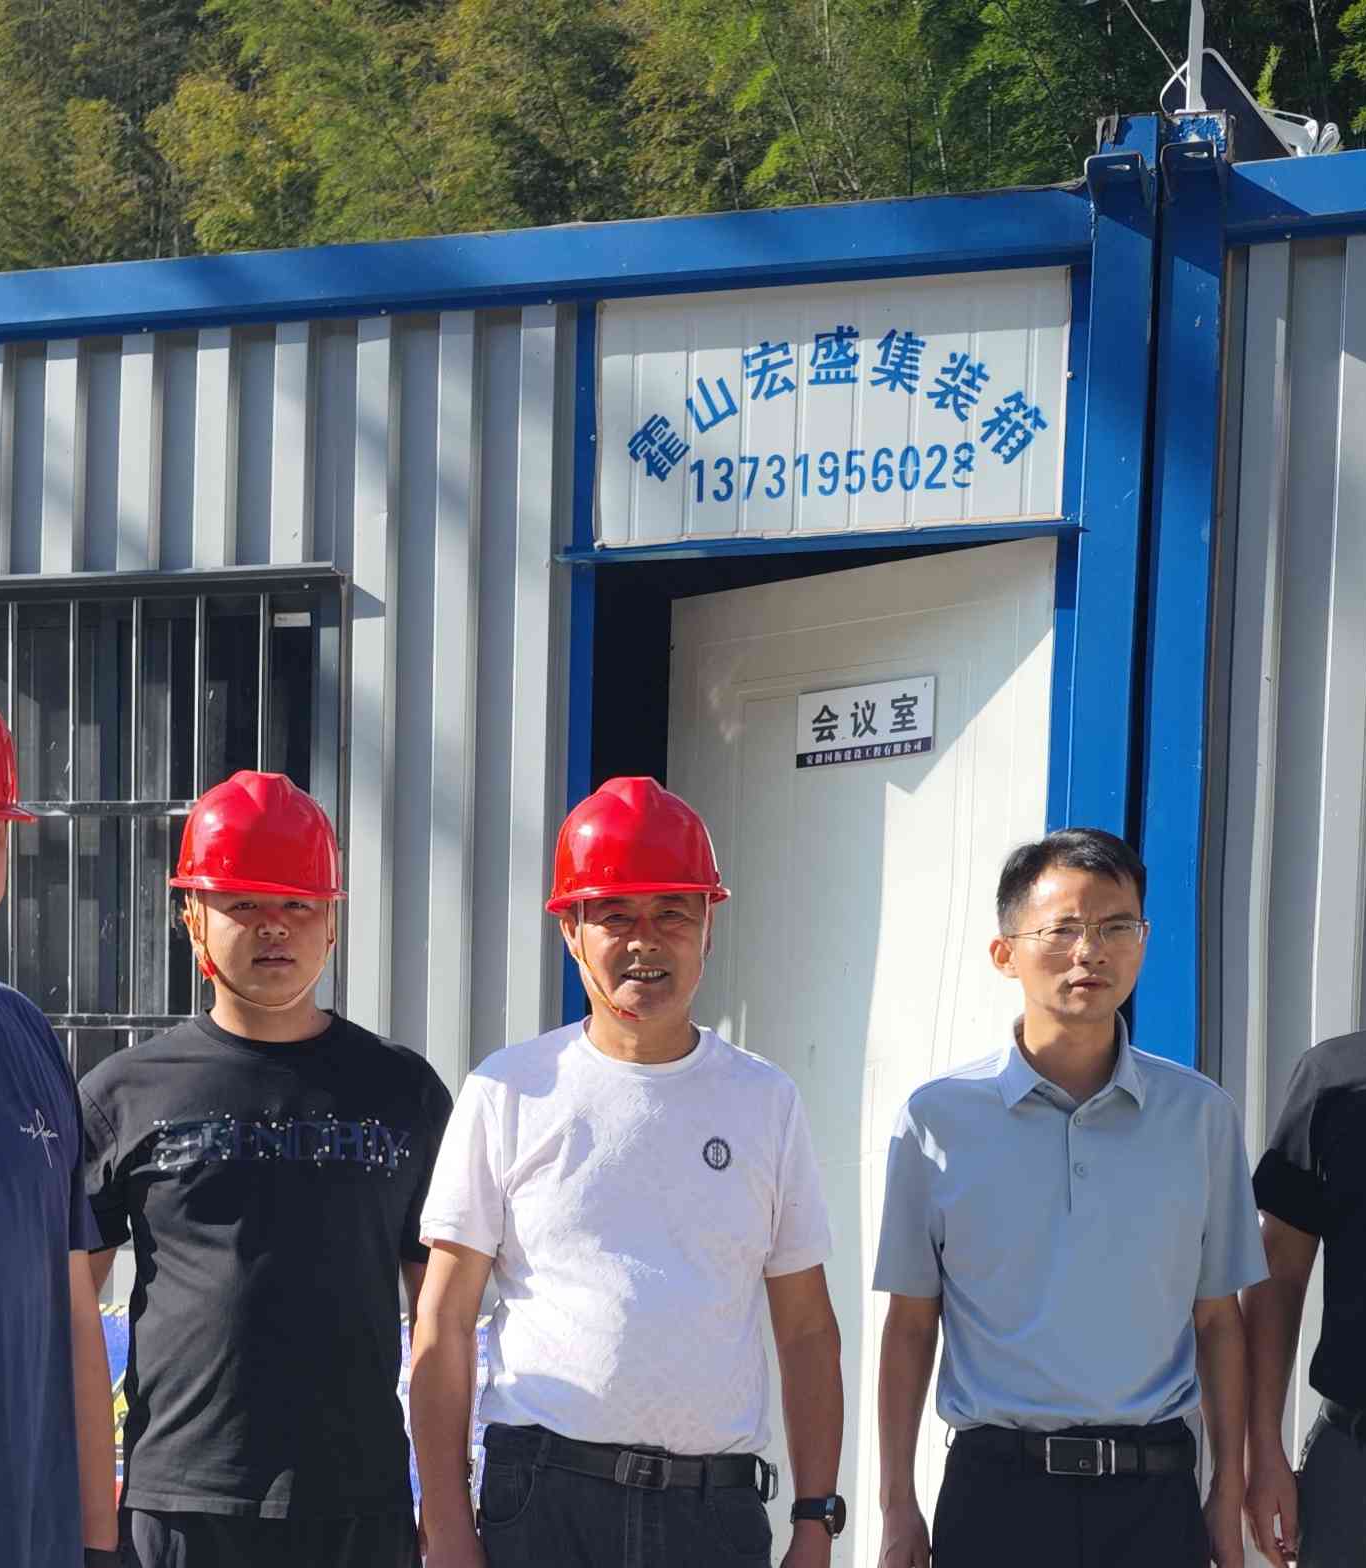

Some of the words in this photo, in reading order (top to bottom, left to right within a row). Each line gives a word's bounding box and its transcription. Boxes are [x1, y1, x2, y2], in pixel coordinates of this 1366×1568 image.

[627, 325, 1048, 484] 霍山宏盛集装箱
[689, 441, 976, 503] 13731956028
[811, 693, 919, 743] 会议室
